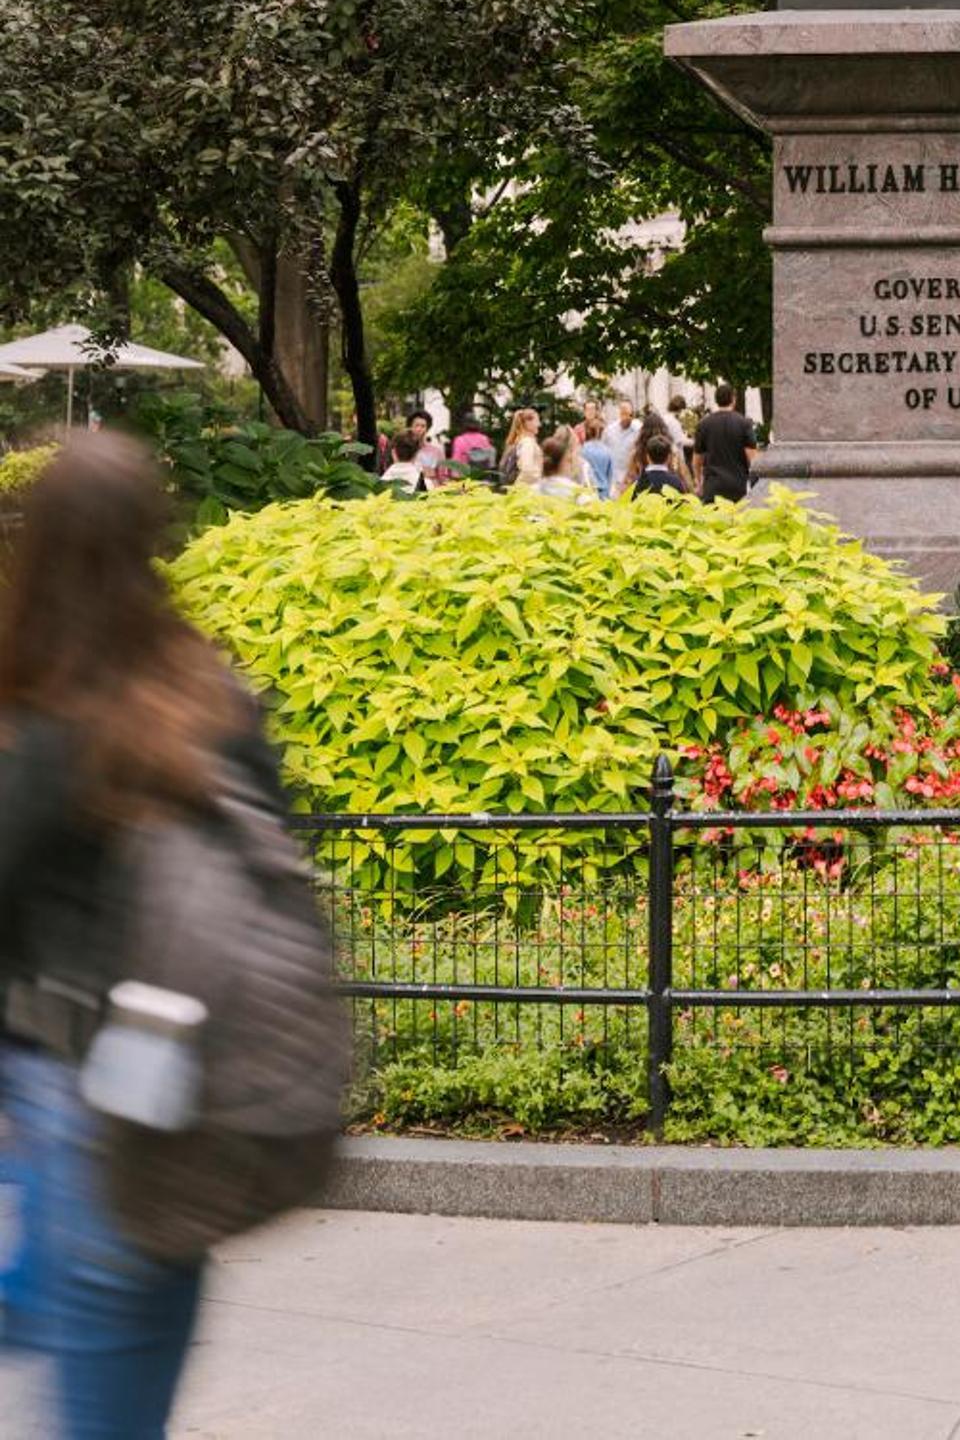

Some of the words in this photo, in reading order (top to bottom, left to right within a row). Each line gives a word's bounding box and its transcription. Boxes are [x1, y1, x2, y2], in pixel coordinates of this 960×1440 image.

[783, 164, 925, 193] WILLIAM
[804, 351, 957, 374] SECRETARY
[905, 388, 937, 409] OF
